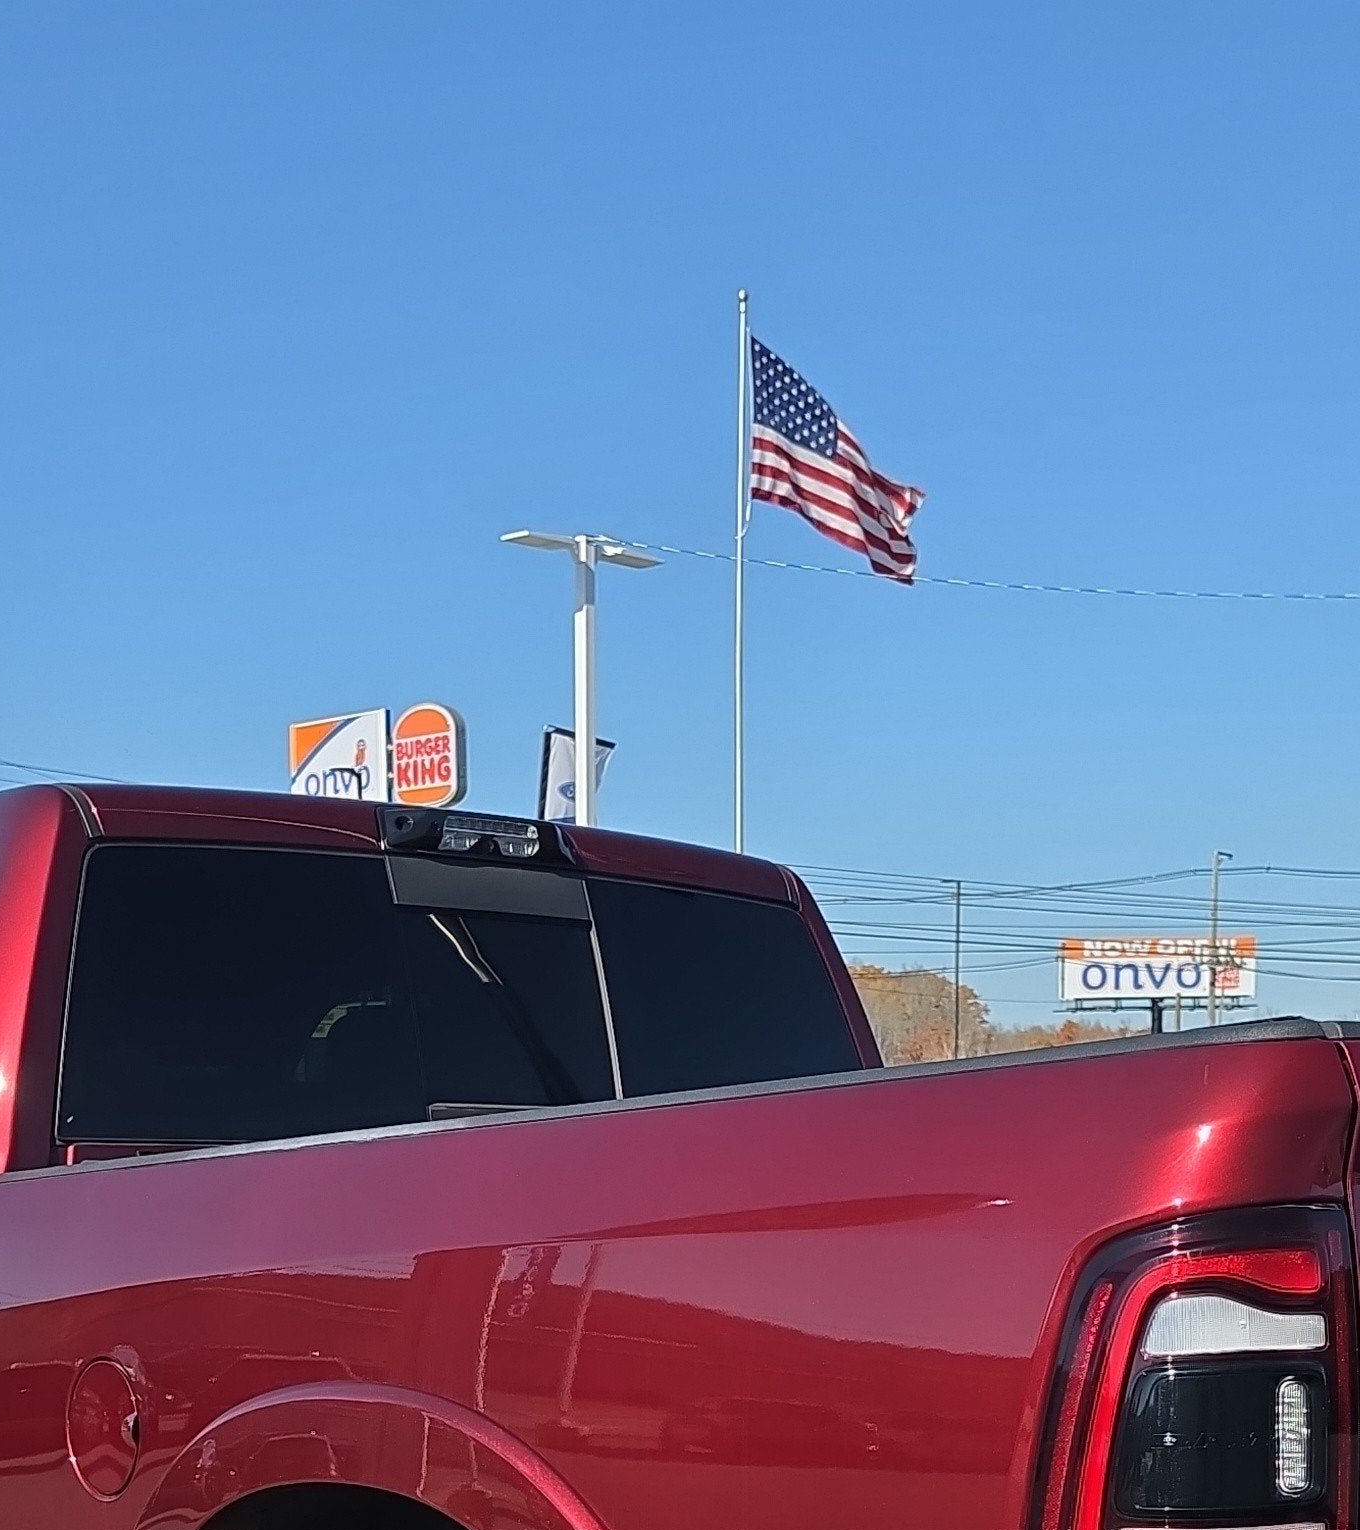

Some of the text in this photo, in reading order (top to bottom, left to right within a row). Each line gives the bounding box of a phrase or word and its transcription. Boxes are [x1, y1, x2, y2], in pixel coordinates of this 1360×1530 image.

[396, 734, 451, 761] BURGER
[396, 755, 452, 789] KING
[1083, 939, 1152, 958] NOW
[1081, 962, 1202, 991] onvo
